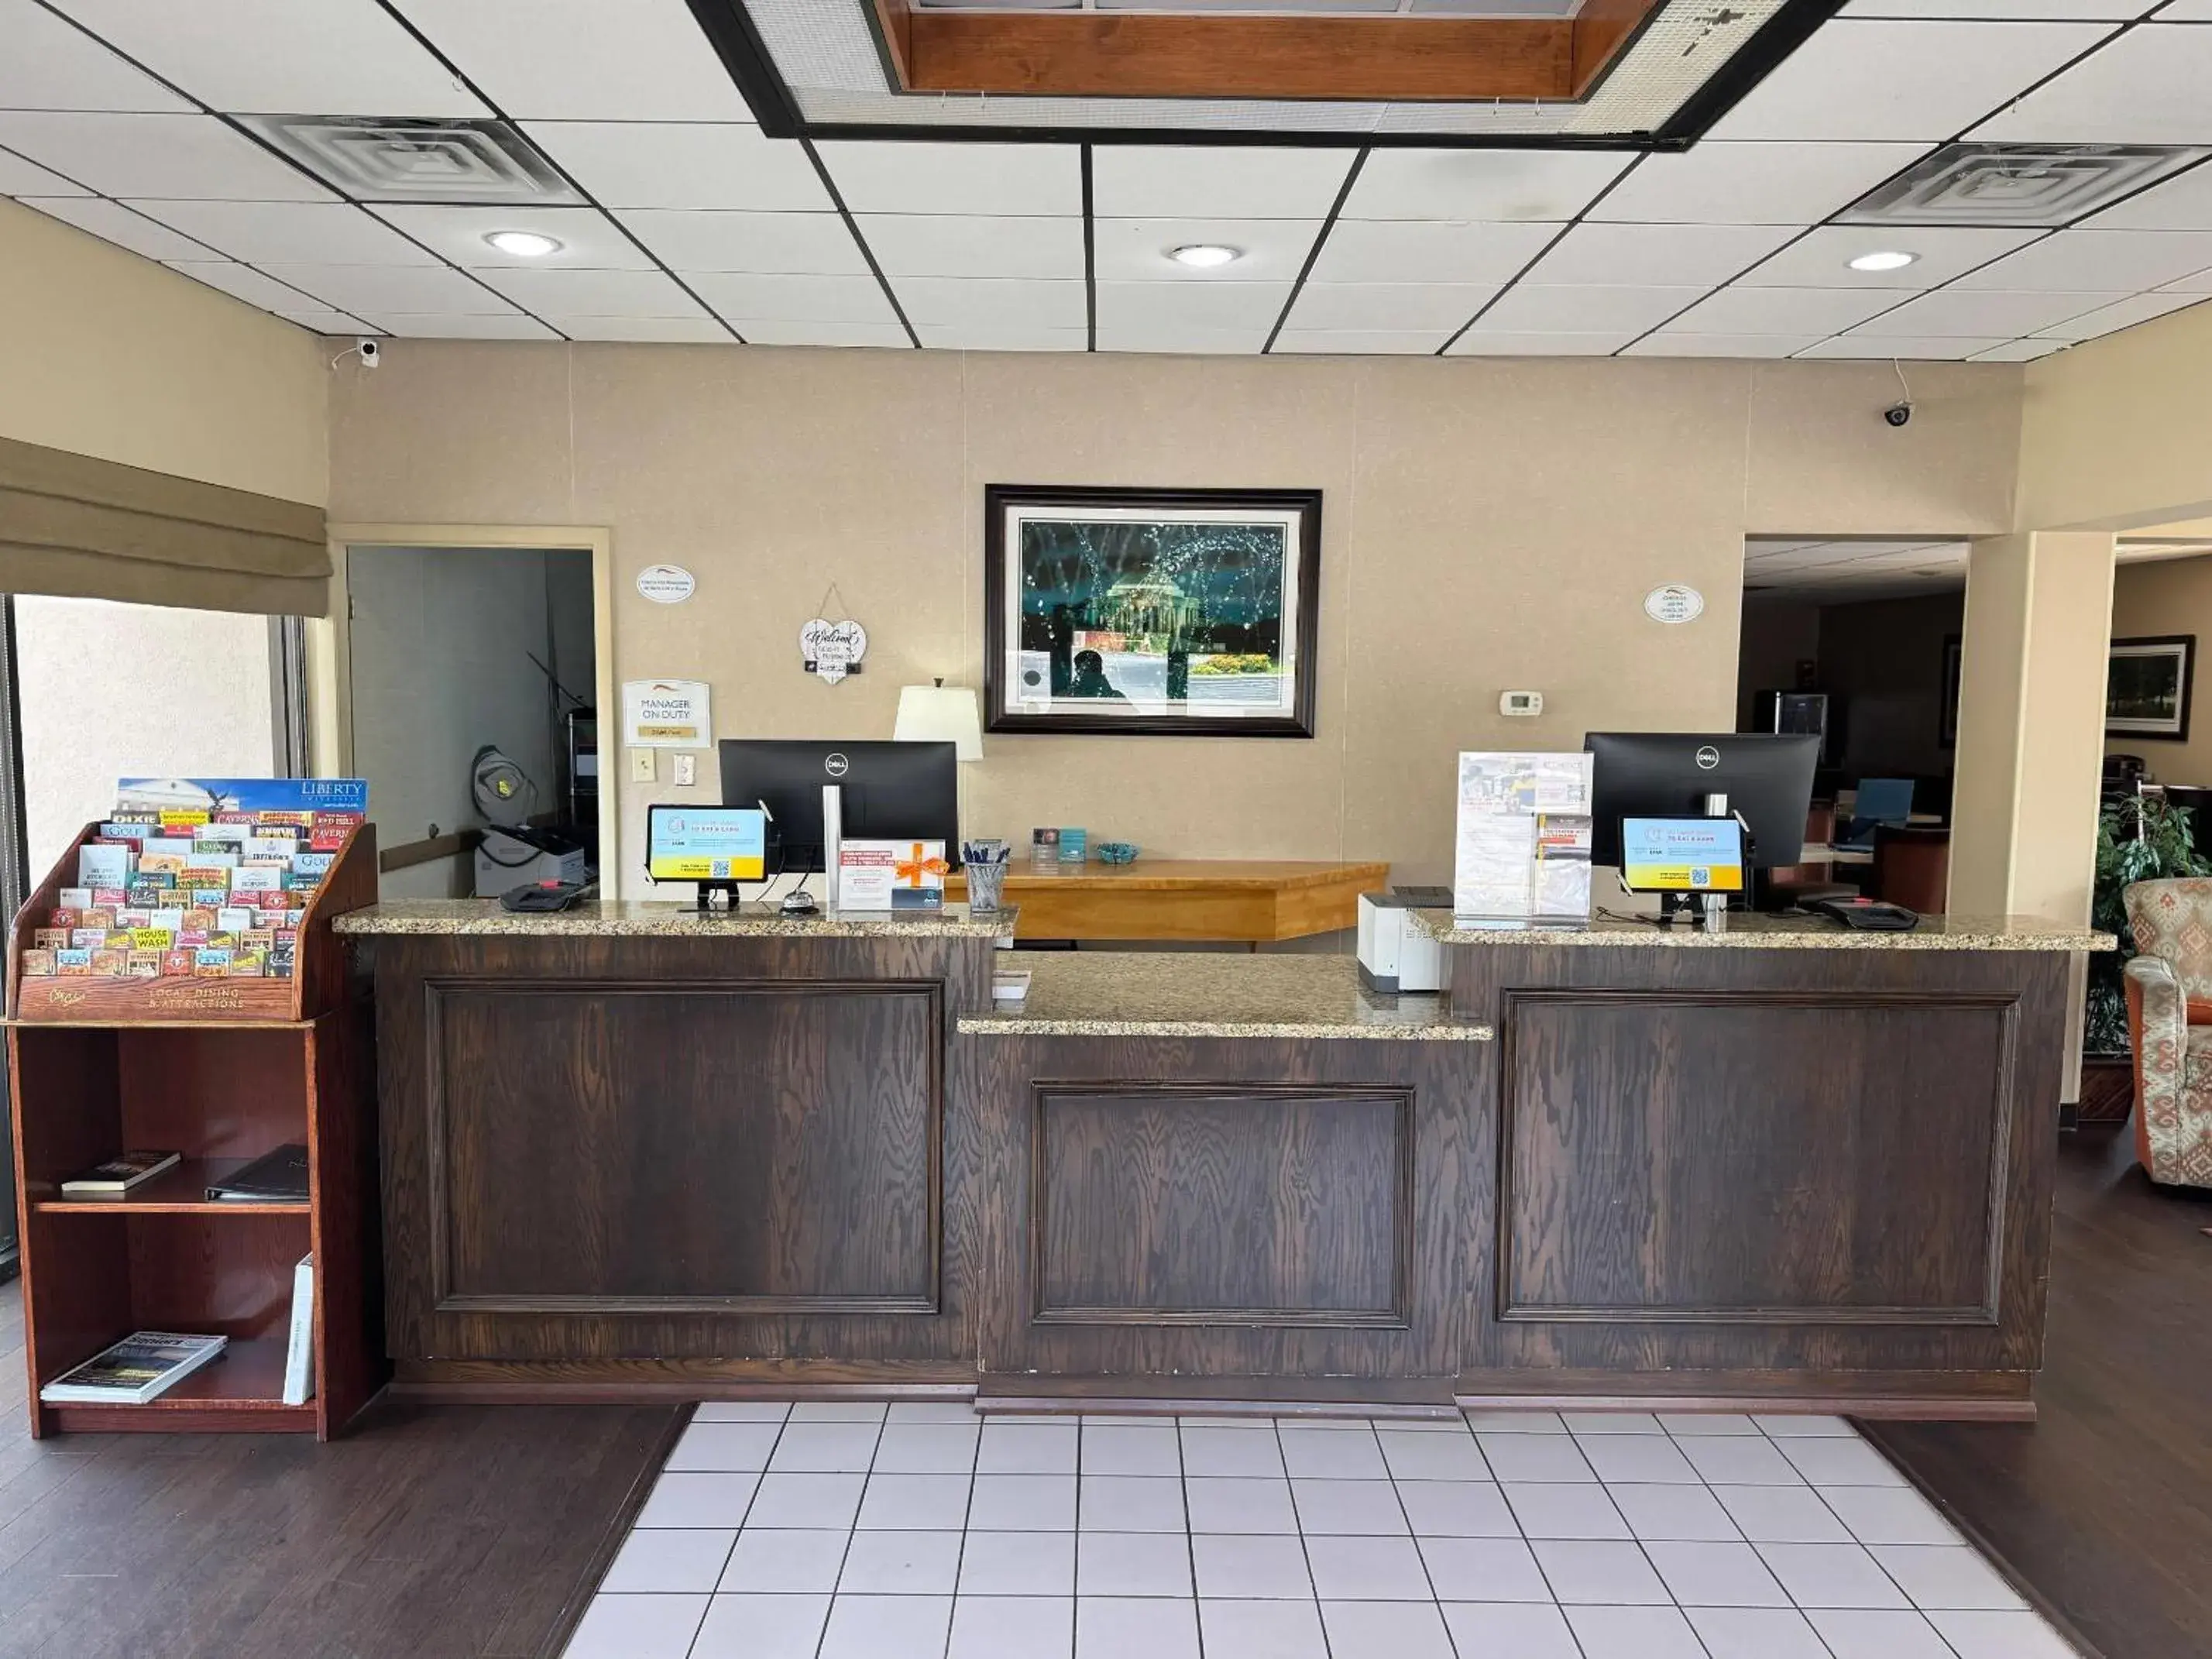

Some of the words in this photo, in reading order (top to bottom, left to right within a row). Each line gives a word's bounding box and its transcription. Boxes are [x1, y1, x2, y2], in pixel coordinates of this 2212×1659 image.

[641, 699, 690, 709] MANAGER
[642, 710, 660, 719] ON
[661, 710, 691, 719] DUTY
[301, 781, 362, 795] LIBERTY
[112, 814, 156, 824] DIXIE
[311, 828, 350, 840] CAVERN
[301, 855, 332, 867] GOL
[136, 929, 167, 938] HOUSE
[138, 939, 168, 947] WASH
[149, 988, 187, 997] LOCA
[195, 988, 239, 998] DINING
[161, 999, 244, 1008] ATTRACTIONS
